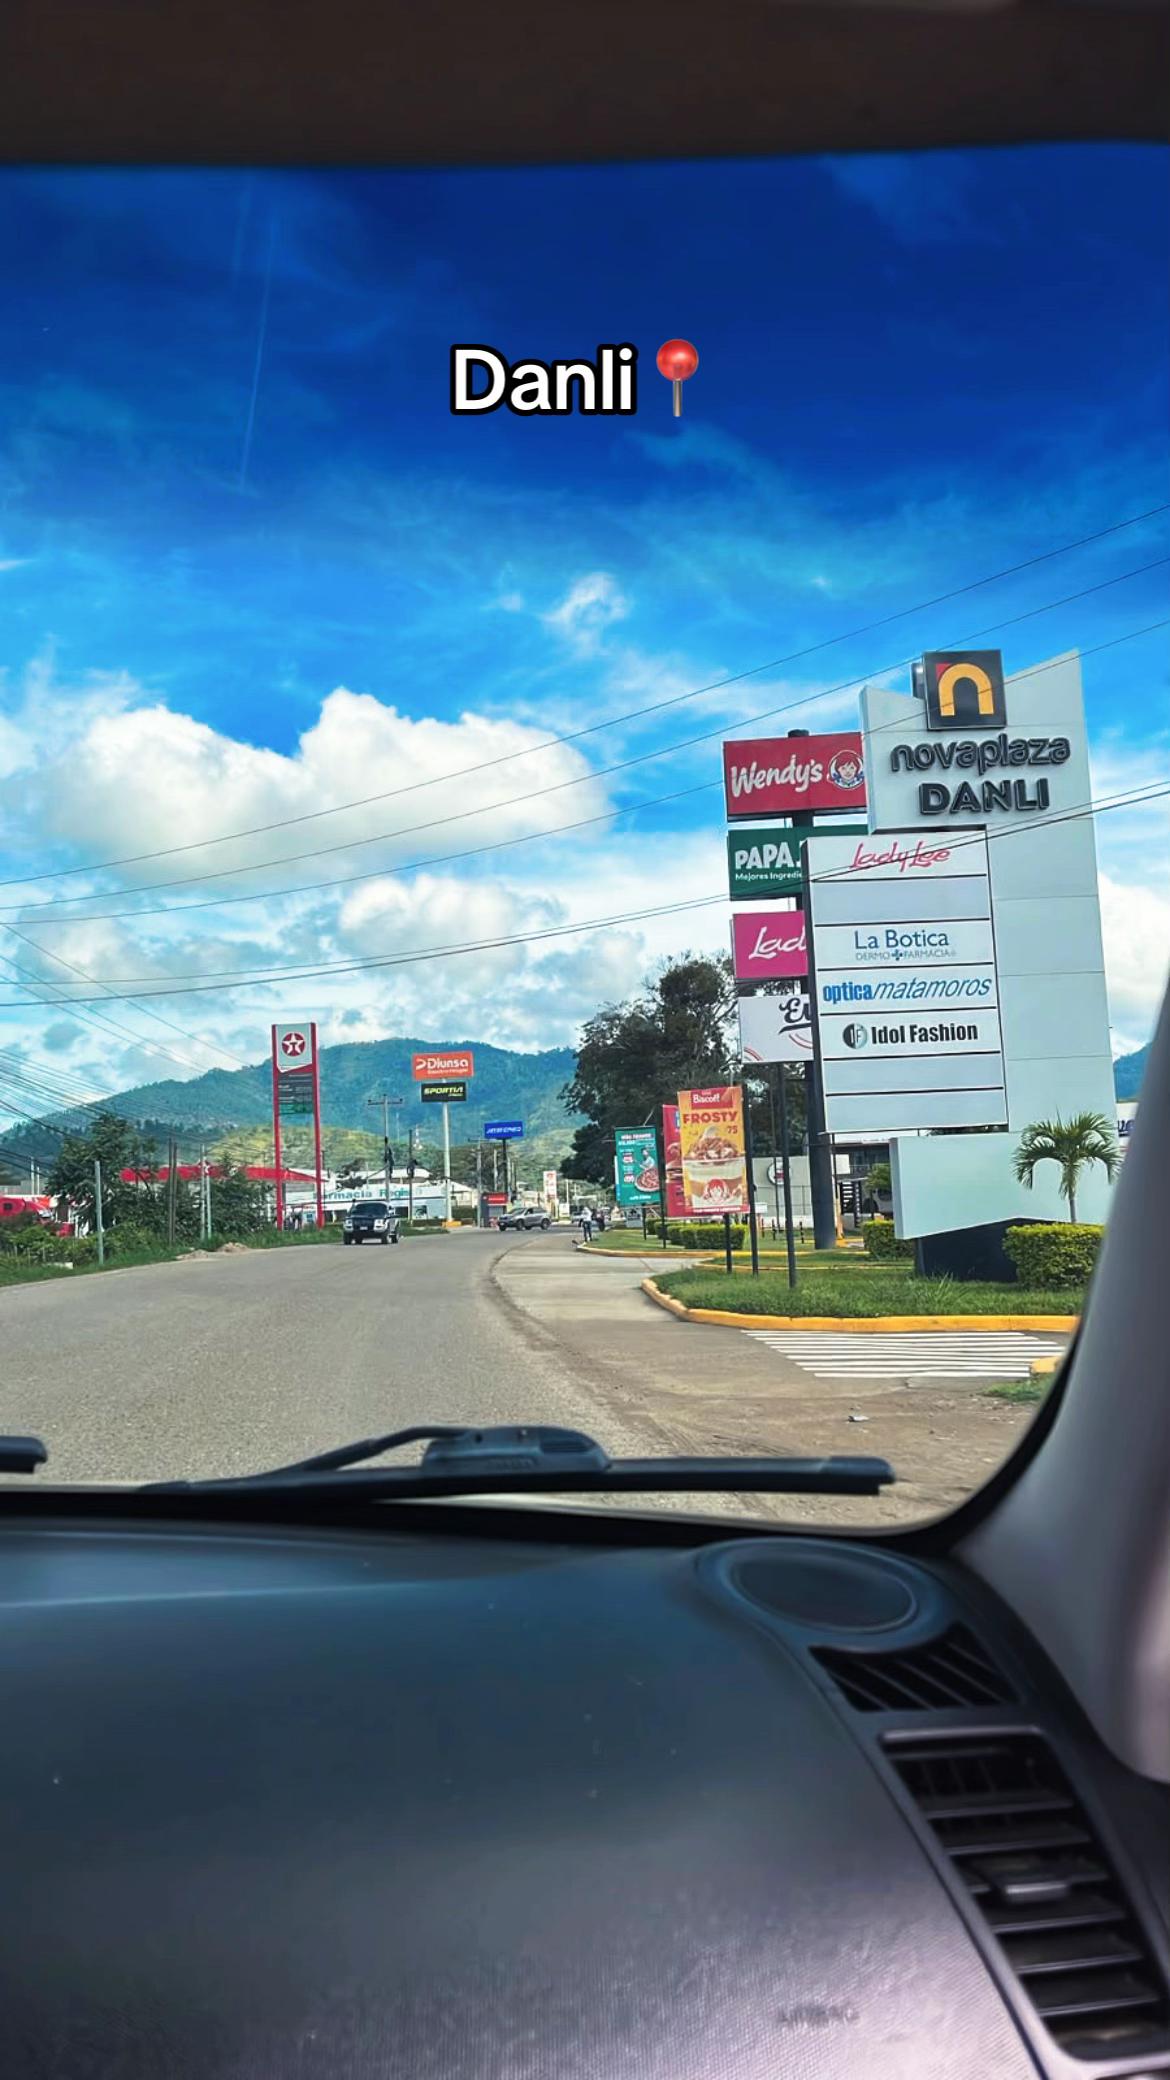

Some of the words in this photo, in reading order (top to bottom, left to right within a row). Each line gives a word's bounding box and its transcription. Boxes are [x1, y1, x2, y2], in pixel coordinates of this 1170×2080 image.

[890, 733, 1071, 776] novaplaza
[730, 754, 823, 798] Wendy's
[918, 778, 1050, 815] DANLI
[735, 842, 795, 870] PAPA
[736, 873, 768, 882] Mejores
[855, 930, 879, 950] La
[885, 929, 949, 949] Botica
[856, 952, 891, 961] DERMO
[904, 949, 952, 959] FARMACIA
[871, 1025, 906, 1045] Idol
[909, 1023, 979, 1043] Fashion
[427, 1057, 469, 1070] Diunsa
[683, 1111, 738, 1124] FROSTY
